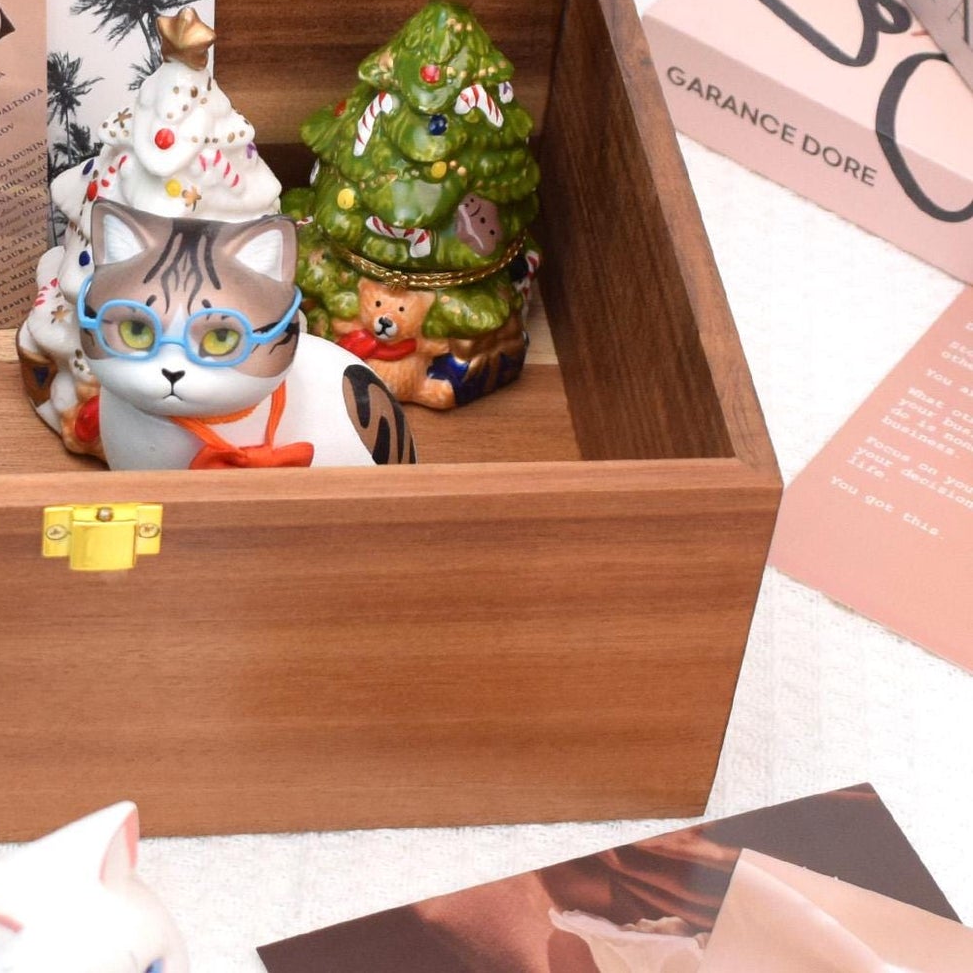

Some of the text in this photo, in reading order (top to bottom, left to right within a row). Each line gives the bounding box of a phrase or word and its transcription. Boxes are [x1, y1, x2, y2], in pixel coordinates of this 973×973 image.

[667, 66, 877, 187] GARANCE DORE
[927, 368, 953, 386] You
[899, 398, 937, 418] your
[908, 387, 945, 408] What
[890, 407, 910, 420] do
[917, 419, 937, 432] is
[881, 415, 961, 460] business.
[846, 455, 889, 482] life.
[854, 446, 893, 468] your
[865, 436, 910, 463] Focus
[918, 463, 938, 476] on
[830, 475, 944, 540] You got this.
